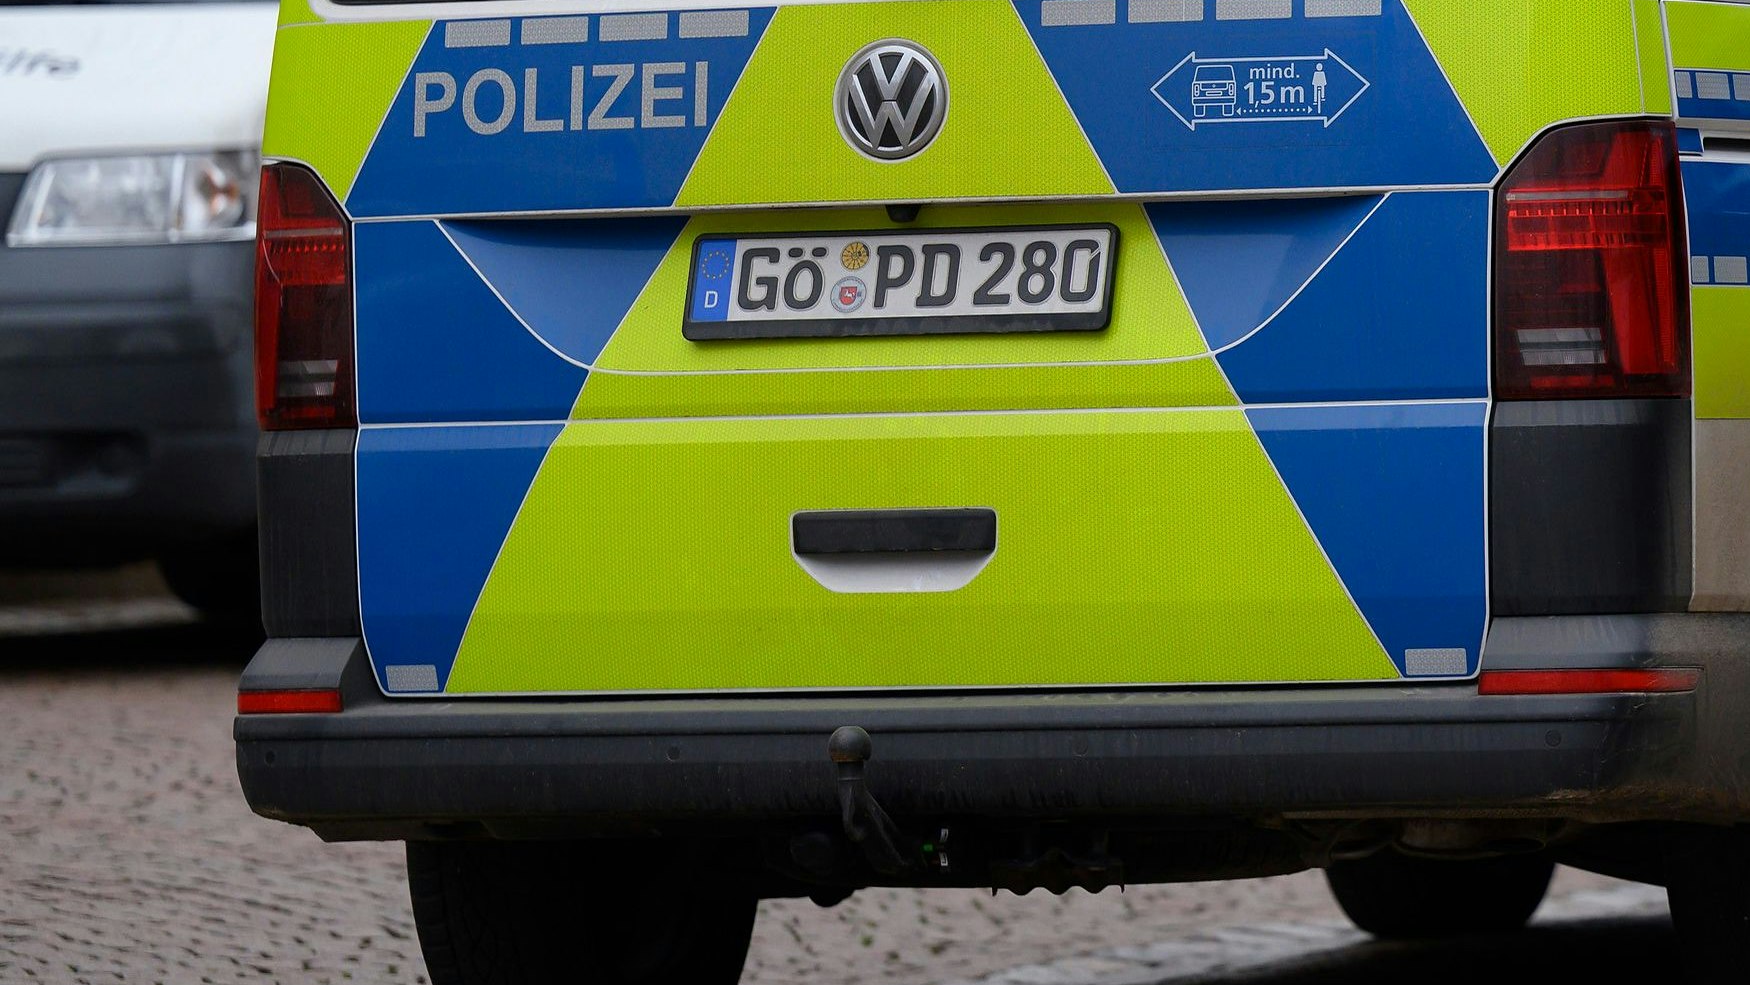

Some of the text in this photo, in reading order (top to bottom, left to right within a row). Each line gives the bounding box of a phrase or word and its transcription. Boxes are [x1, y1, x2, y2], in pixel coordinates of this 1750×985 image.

[1243, 81, 1305, 107] 1,5 m
[1248, 62, 1300, 80] mind.
[412, 60, 709, 138] POLIZEI
[842, 46, 940, 154] VW
[704, 290, 718, 308] D
[737, 246, 825, 311] GÖ
[873, 243, 962, 308] PD
[973, 239, 1101, 305] 280
